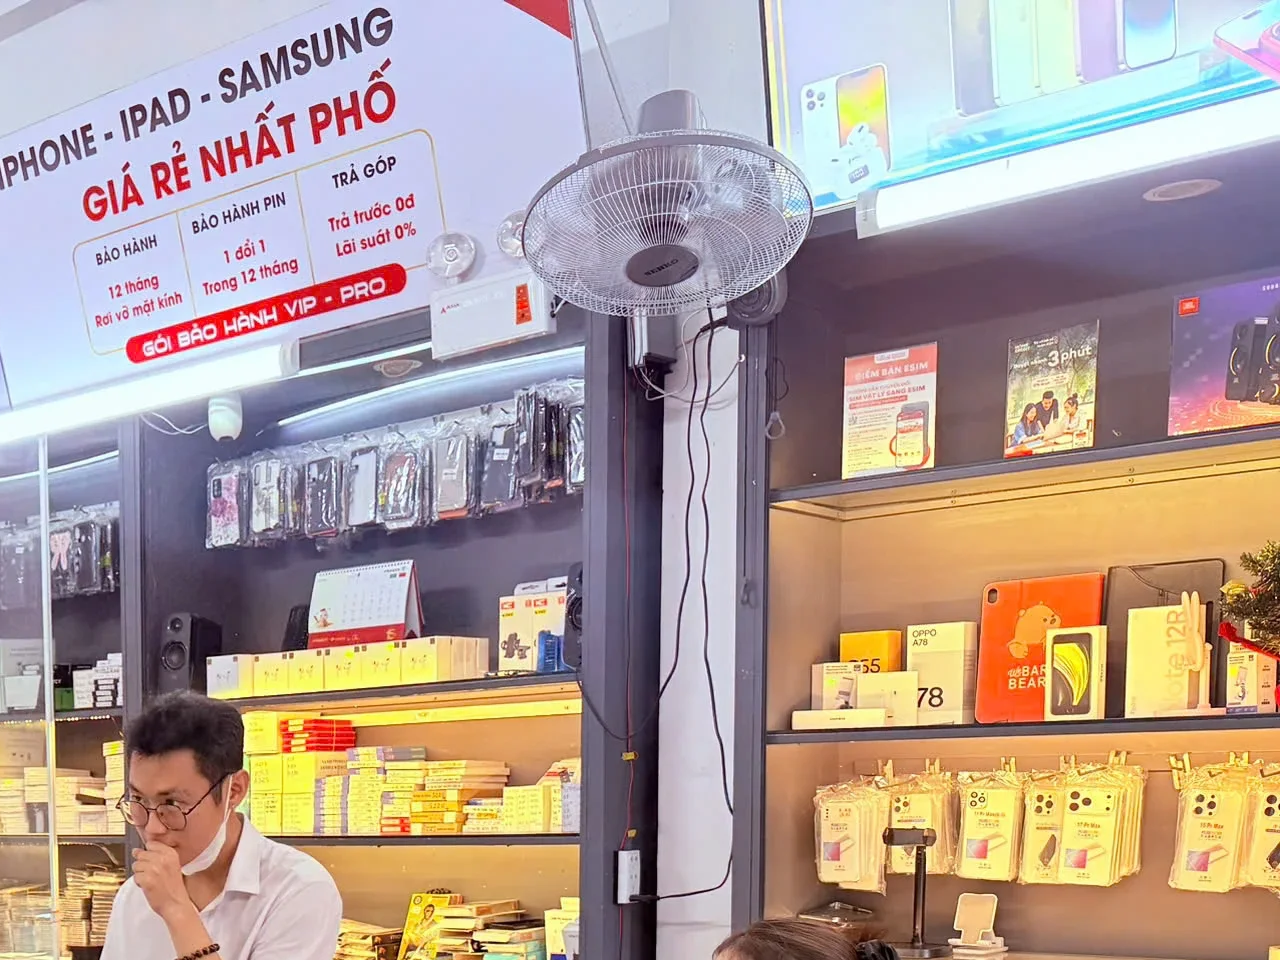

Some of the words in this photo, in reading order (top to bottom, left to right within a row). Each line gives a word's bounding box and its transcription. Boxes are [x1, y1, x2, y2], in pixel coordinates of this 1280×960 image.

[120, 87, 191, 142] IPAD
[218, 7, 393, 104] SAMSUNG
[82, 161, 145, 222] GIÁ
[150, 140, 192, 200] RẺ
[199, 101, 296, 183] NHẤT
[308, 58, 397, 145] PHỐ
[332, 163, 360, 189] TRẢ
[363, 155, 397, 178] GÓP
[191, 213, 219, 234] BẢO
[222, 199, 261, 225] HÀNH
[263, 192, 287, 211] PIN
[328, 211, 351, 232] Trả
[353, 202, 392, 225] trước
[95, 245, 120, 266] BẢO
[123, 234, 158, 257] HÀNH
[223, 250, 230, 263] 1
[235, 238, 256, 260] đổi
[258, 239, 266, 253] 1
[336, 238, 357, 257] Lãi
[395, 221, 416, 240] 0%
[108, 284, 123, 299] 12
[124, 276, 160, 295] tháng
[202, 276, 238, 296] Trong
[240, 268, 257, 284] 12
[259, 258, 299, 279] tháng
[157, 291, 183, 310] kính
[142, 333, 172, 357] GÓI
[177, 320, 218, 349] BẢO
[223, 306, 279, 336] HÀNH
[283, 296, 318, 319] VIP
[340, 277, 386, 303] PRO
[1047, 350, 1060, 367] 3
[1061, 345, 1093, 364] phút
[912, 628, 937, 638] OPPO
[912, 638, 928, 647] A78
[848, 658, 881, 674] 55
